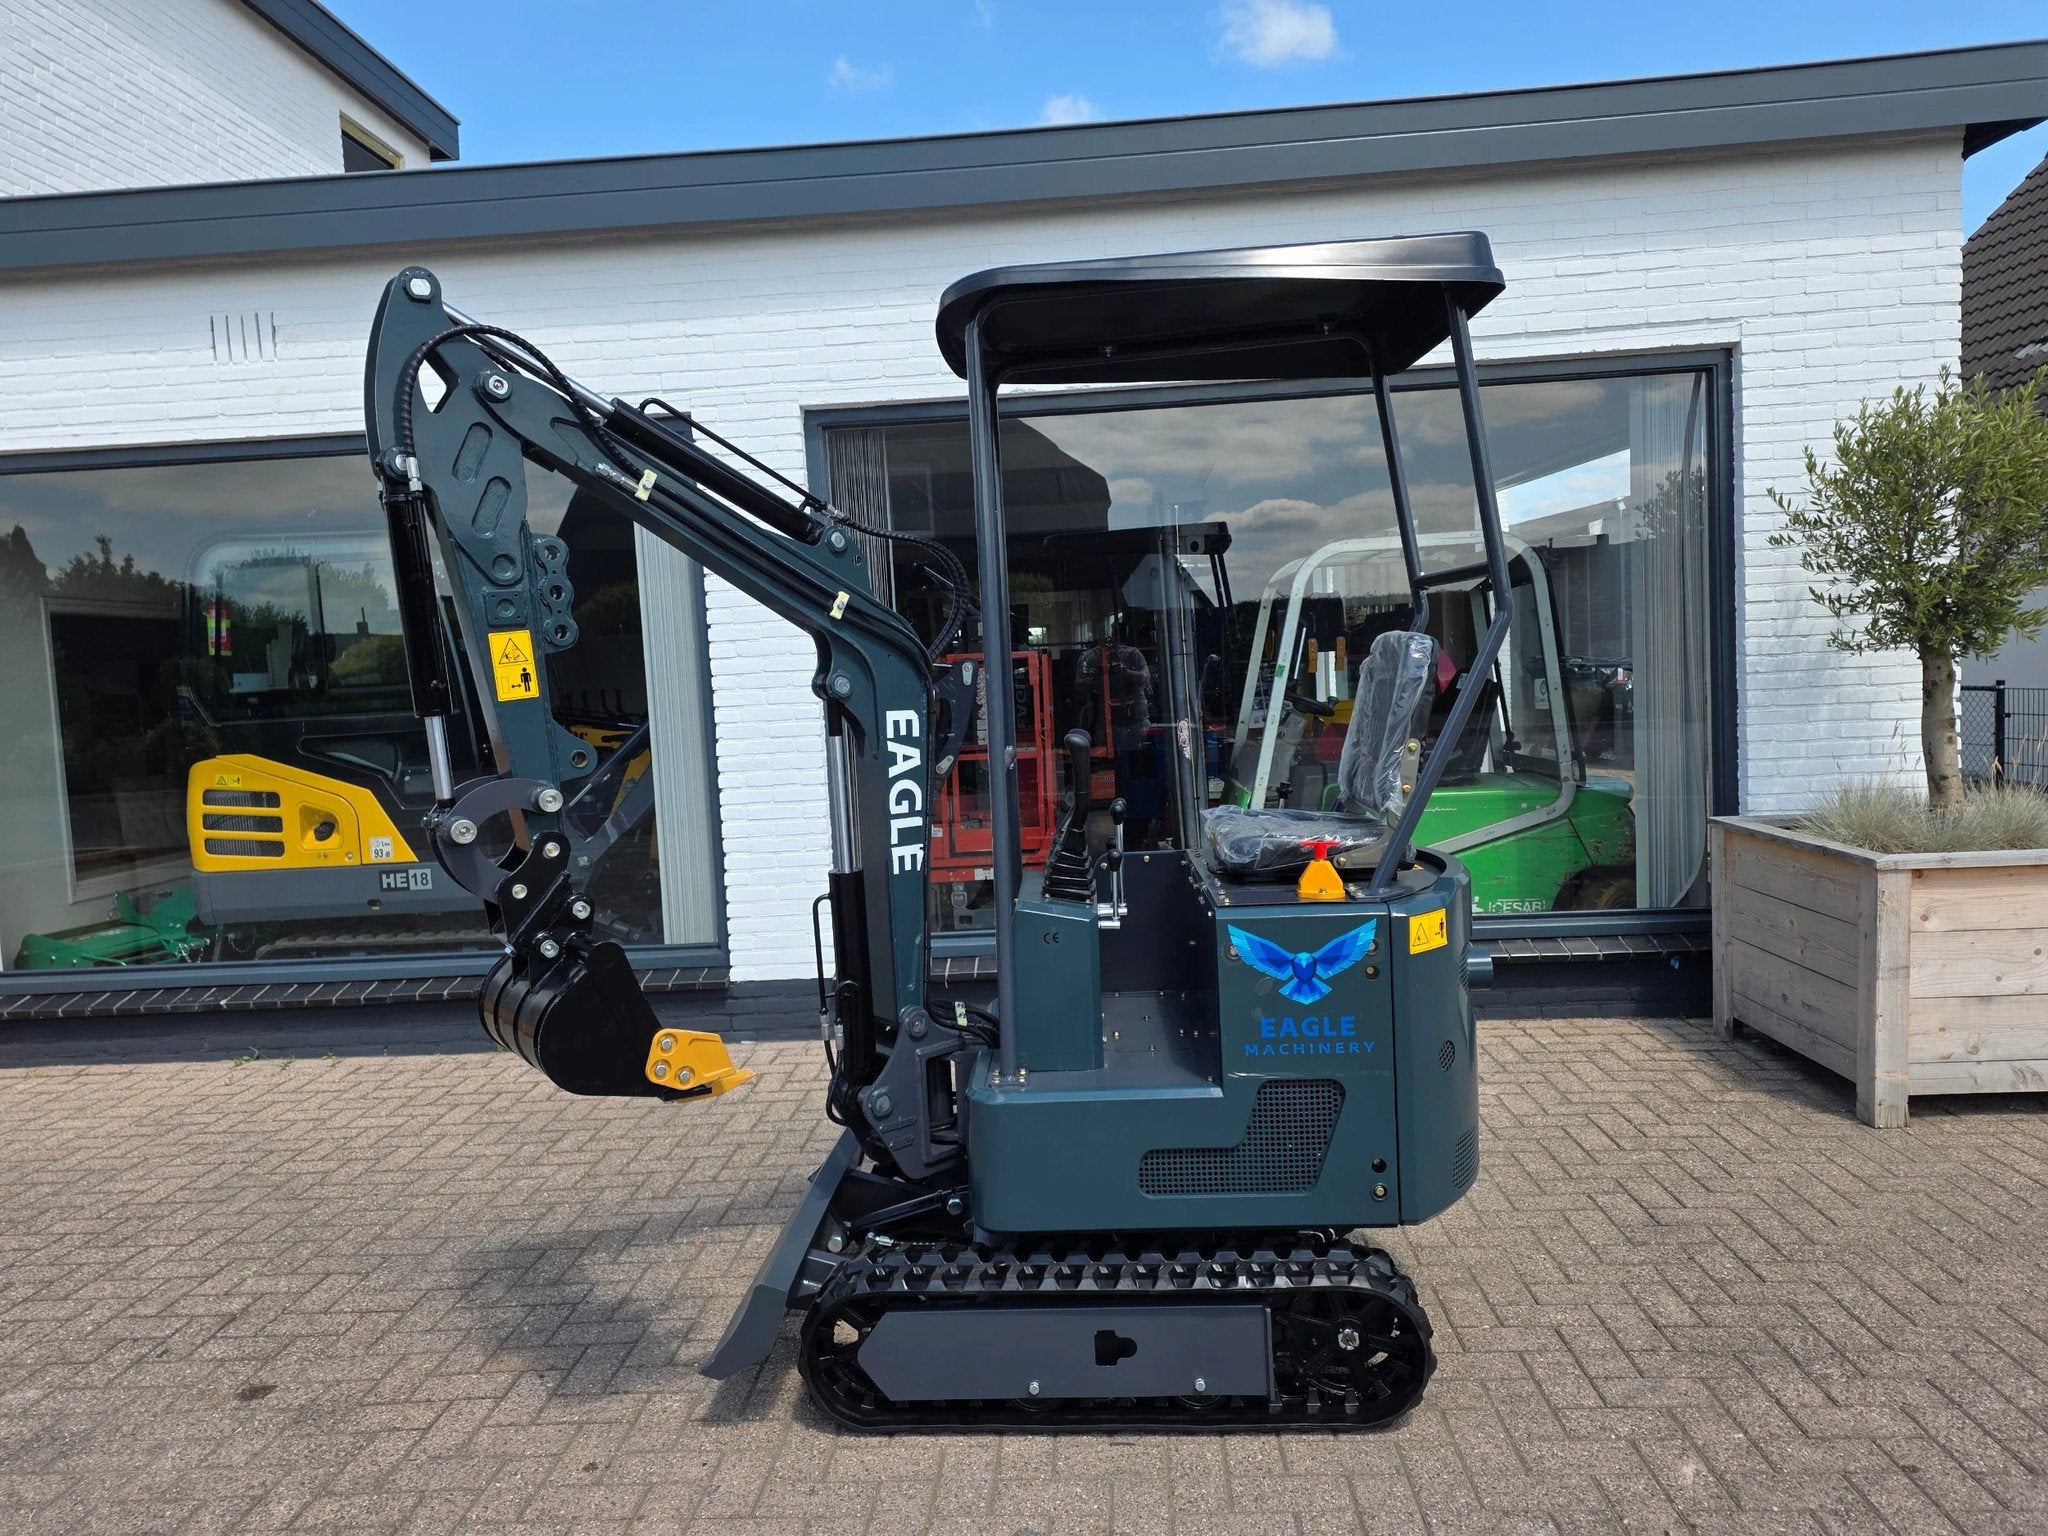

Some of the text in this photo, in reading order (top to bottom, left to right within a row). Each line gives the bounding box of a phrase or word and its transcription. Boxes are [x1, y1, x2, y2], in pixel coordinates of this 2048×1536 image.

[886, 710, 924, 875] EAGLE
[374, 848, 384, 859] 93
[1492, 901, 1541, 913] CESAB
[1260, 1015, 1356, 1038] EAGLE
[1244, 1041, 1376, 1056] MACHINERY
